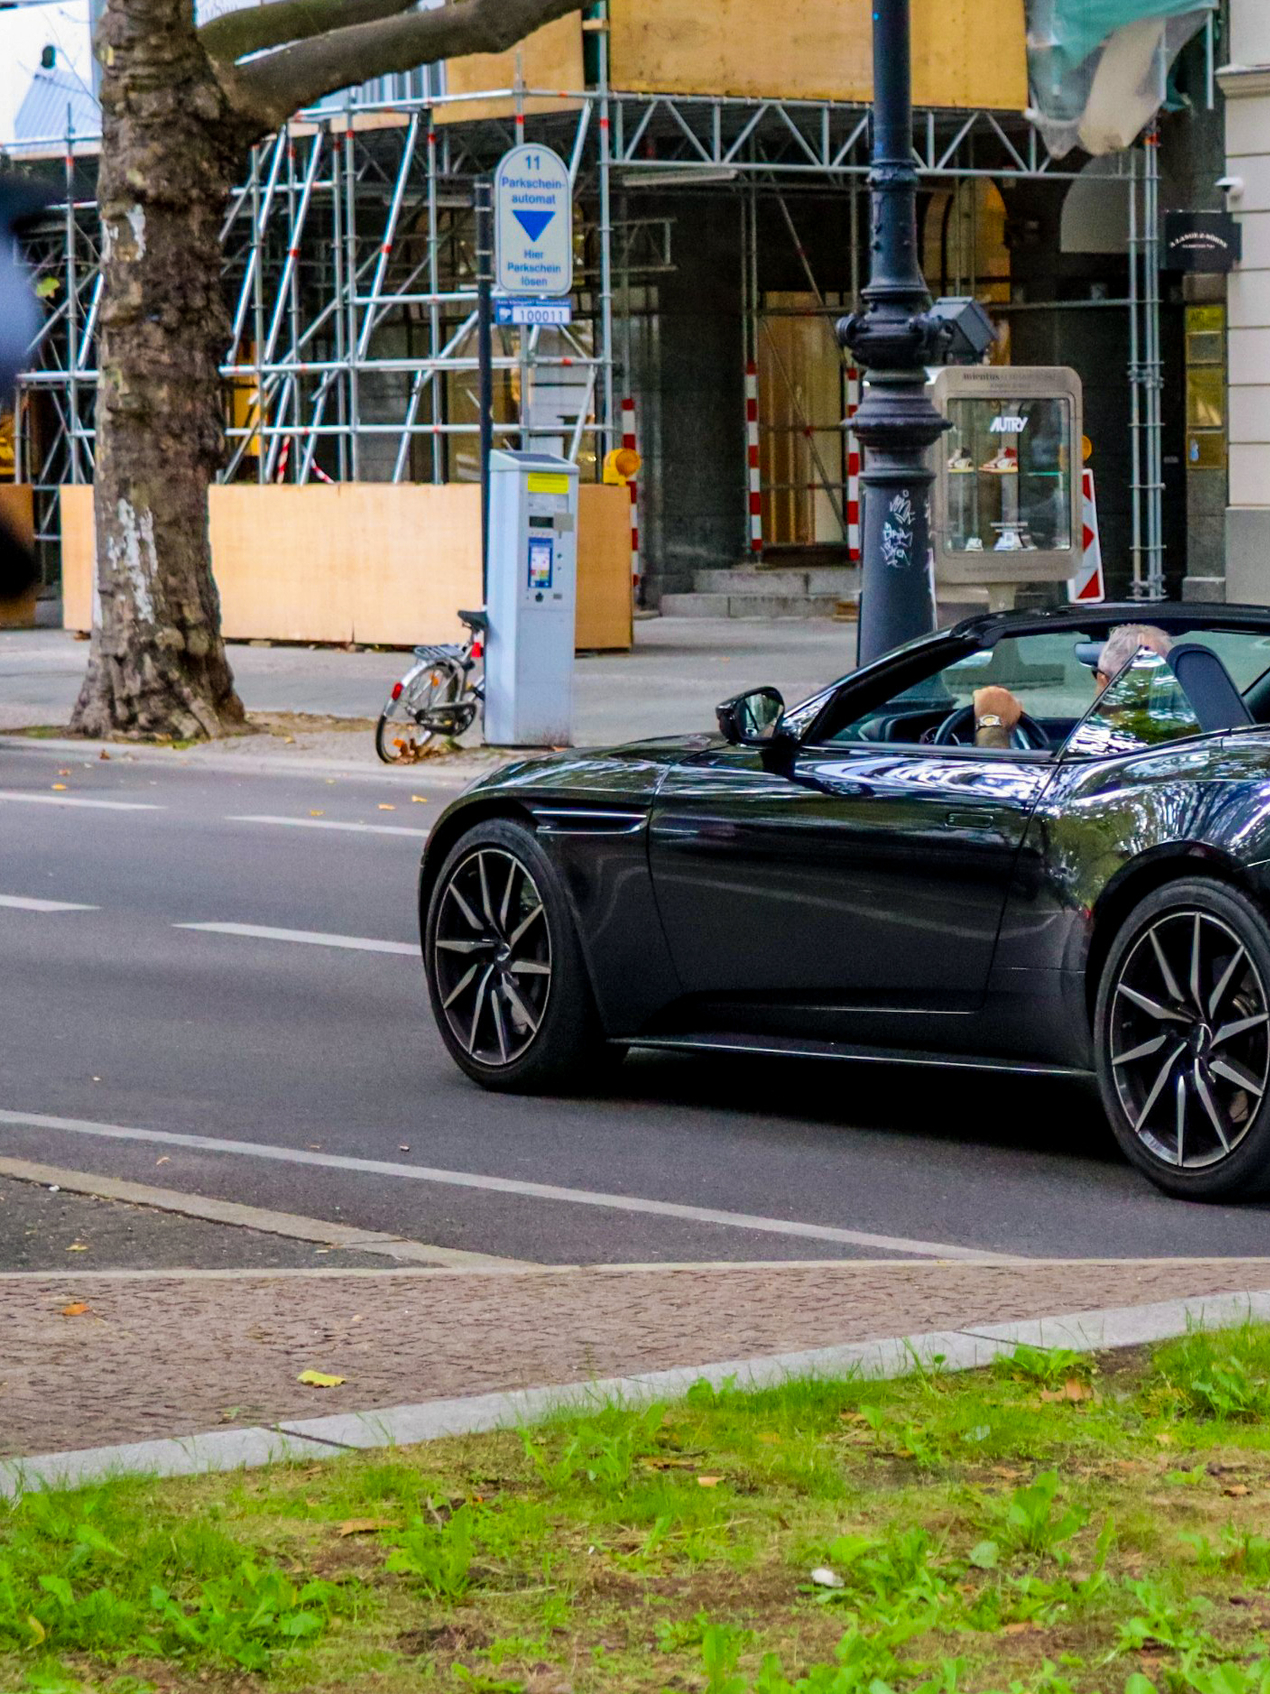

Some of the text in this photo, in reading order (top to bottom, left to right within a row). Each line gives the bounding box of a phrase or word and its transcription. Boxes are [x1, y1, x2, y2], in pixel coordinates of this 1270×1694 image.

[525, 155, 540, 170] 11
[511, 194, 556, 204] automat
[523, 250, 544, 259] Hier
[507, 262, 561, 273] Parkschein
[520, 275, 548, 286] lösen
[520, 310, 563, 321] 100011
[989, 416, 1029, 433] AUTRY
